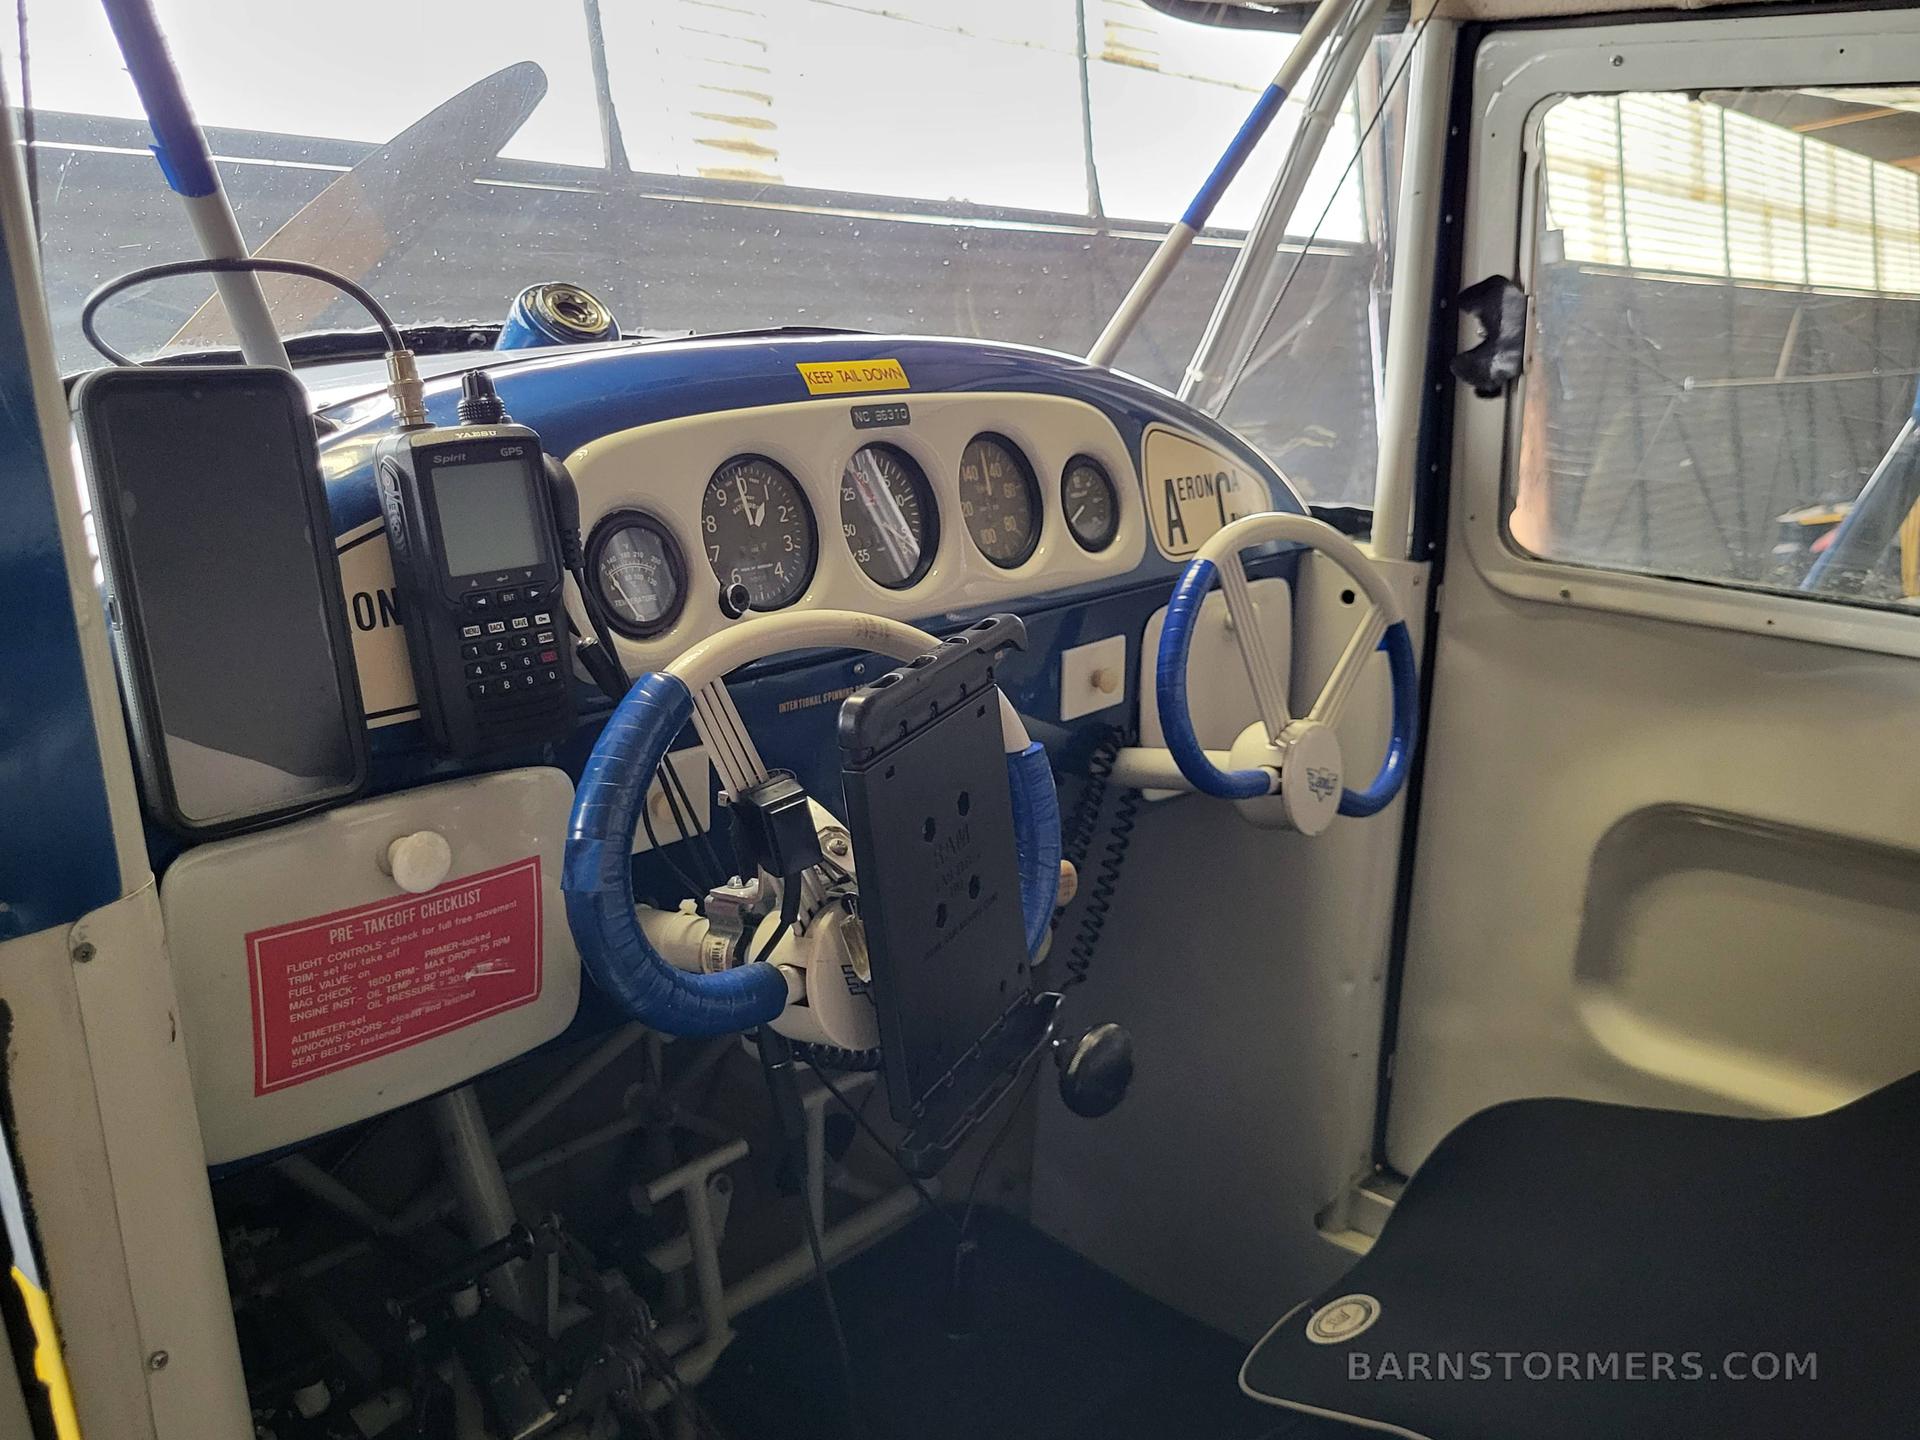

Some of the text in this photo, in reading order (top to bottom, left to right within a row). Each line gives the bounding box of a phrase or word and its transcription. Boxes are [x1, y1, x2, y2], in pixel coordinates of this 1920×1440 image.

[805, 367, 904, 385] KEEP TAIL DOWN
[854, 411, 870, 422] NC
[456, 430, 497, 439] YAESU
[433, 453, 466, 464] Spirit
[500, 446, 524, 457] GPS
[716, 489, 728, 507] 9
[843, 488, 856, 501] 25
[777, 505, 789, 523] 2
[706, 515, 717, 533] 8
[783, 534, 794, 552] 3
[709, 545, 721, 562] 7
[857, 549, 871, 563] 35
[731, 568, 742, 585] 6
[774, 561, 785, 578] 4
[489, 623, 504, 633] BACK
[513, 619, 528, 628] SAVE
[472, 646, 478, 655] 1
[496, 642, 504, 651] 2
[521, 638, 527, 647] 3
[475, 657, 530, 675] 4 5 6
[480, 671, 555, 694] 7 8 9 0
[421, 888, 481, 919] CHECKLIST
[286, 957, 323, 974] FLIGHT
[390, 931, 418, 945] check
[422, 927, 435, 935] for
[438, 920, 452, 931] full
[455, 915, 473, 925] free
[475, 900, 517, 920] movement
[323, 966, 339, 977] set
[343, 962, 357, 971] for
[361, 954, 383, 966] take
[386, 946, 400, 958] off
[289, 998, 313, 1011] MAG
[424, 957, 444, 970] MAX
[480, 942, 490, 952] 75
[493, 935, 510, 948] RPM
[288, 985, 315, 999] FUEL
[358, 970, 370, 979] on
[289, 1004, 329, 1023] ENGINE
[366, 989, 382, 1000] OIL
[386, 979, 412, 993] TEMP
[367, 1000, 383, 1010] OIL
[386, 981, 435, 1004] PRESSURE
[291, 1053, 317, 1068] SEAT
[360, 1026, 401, 1046] fastened
